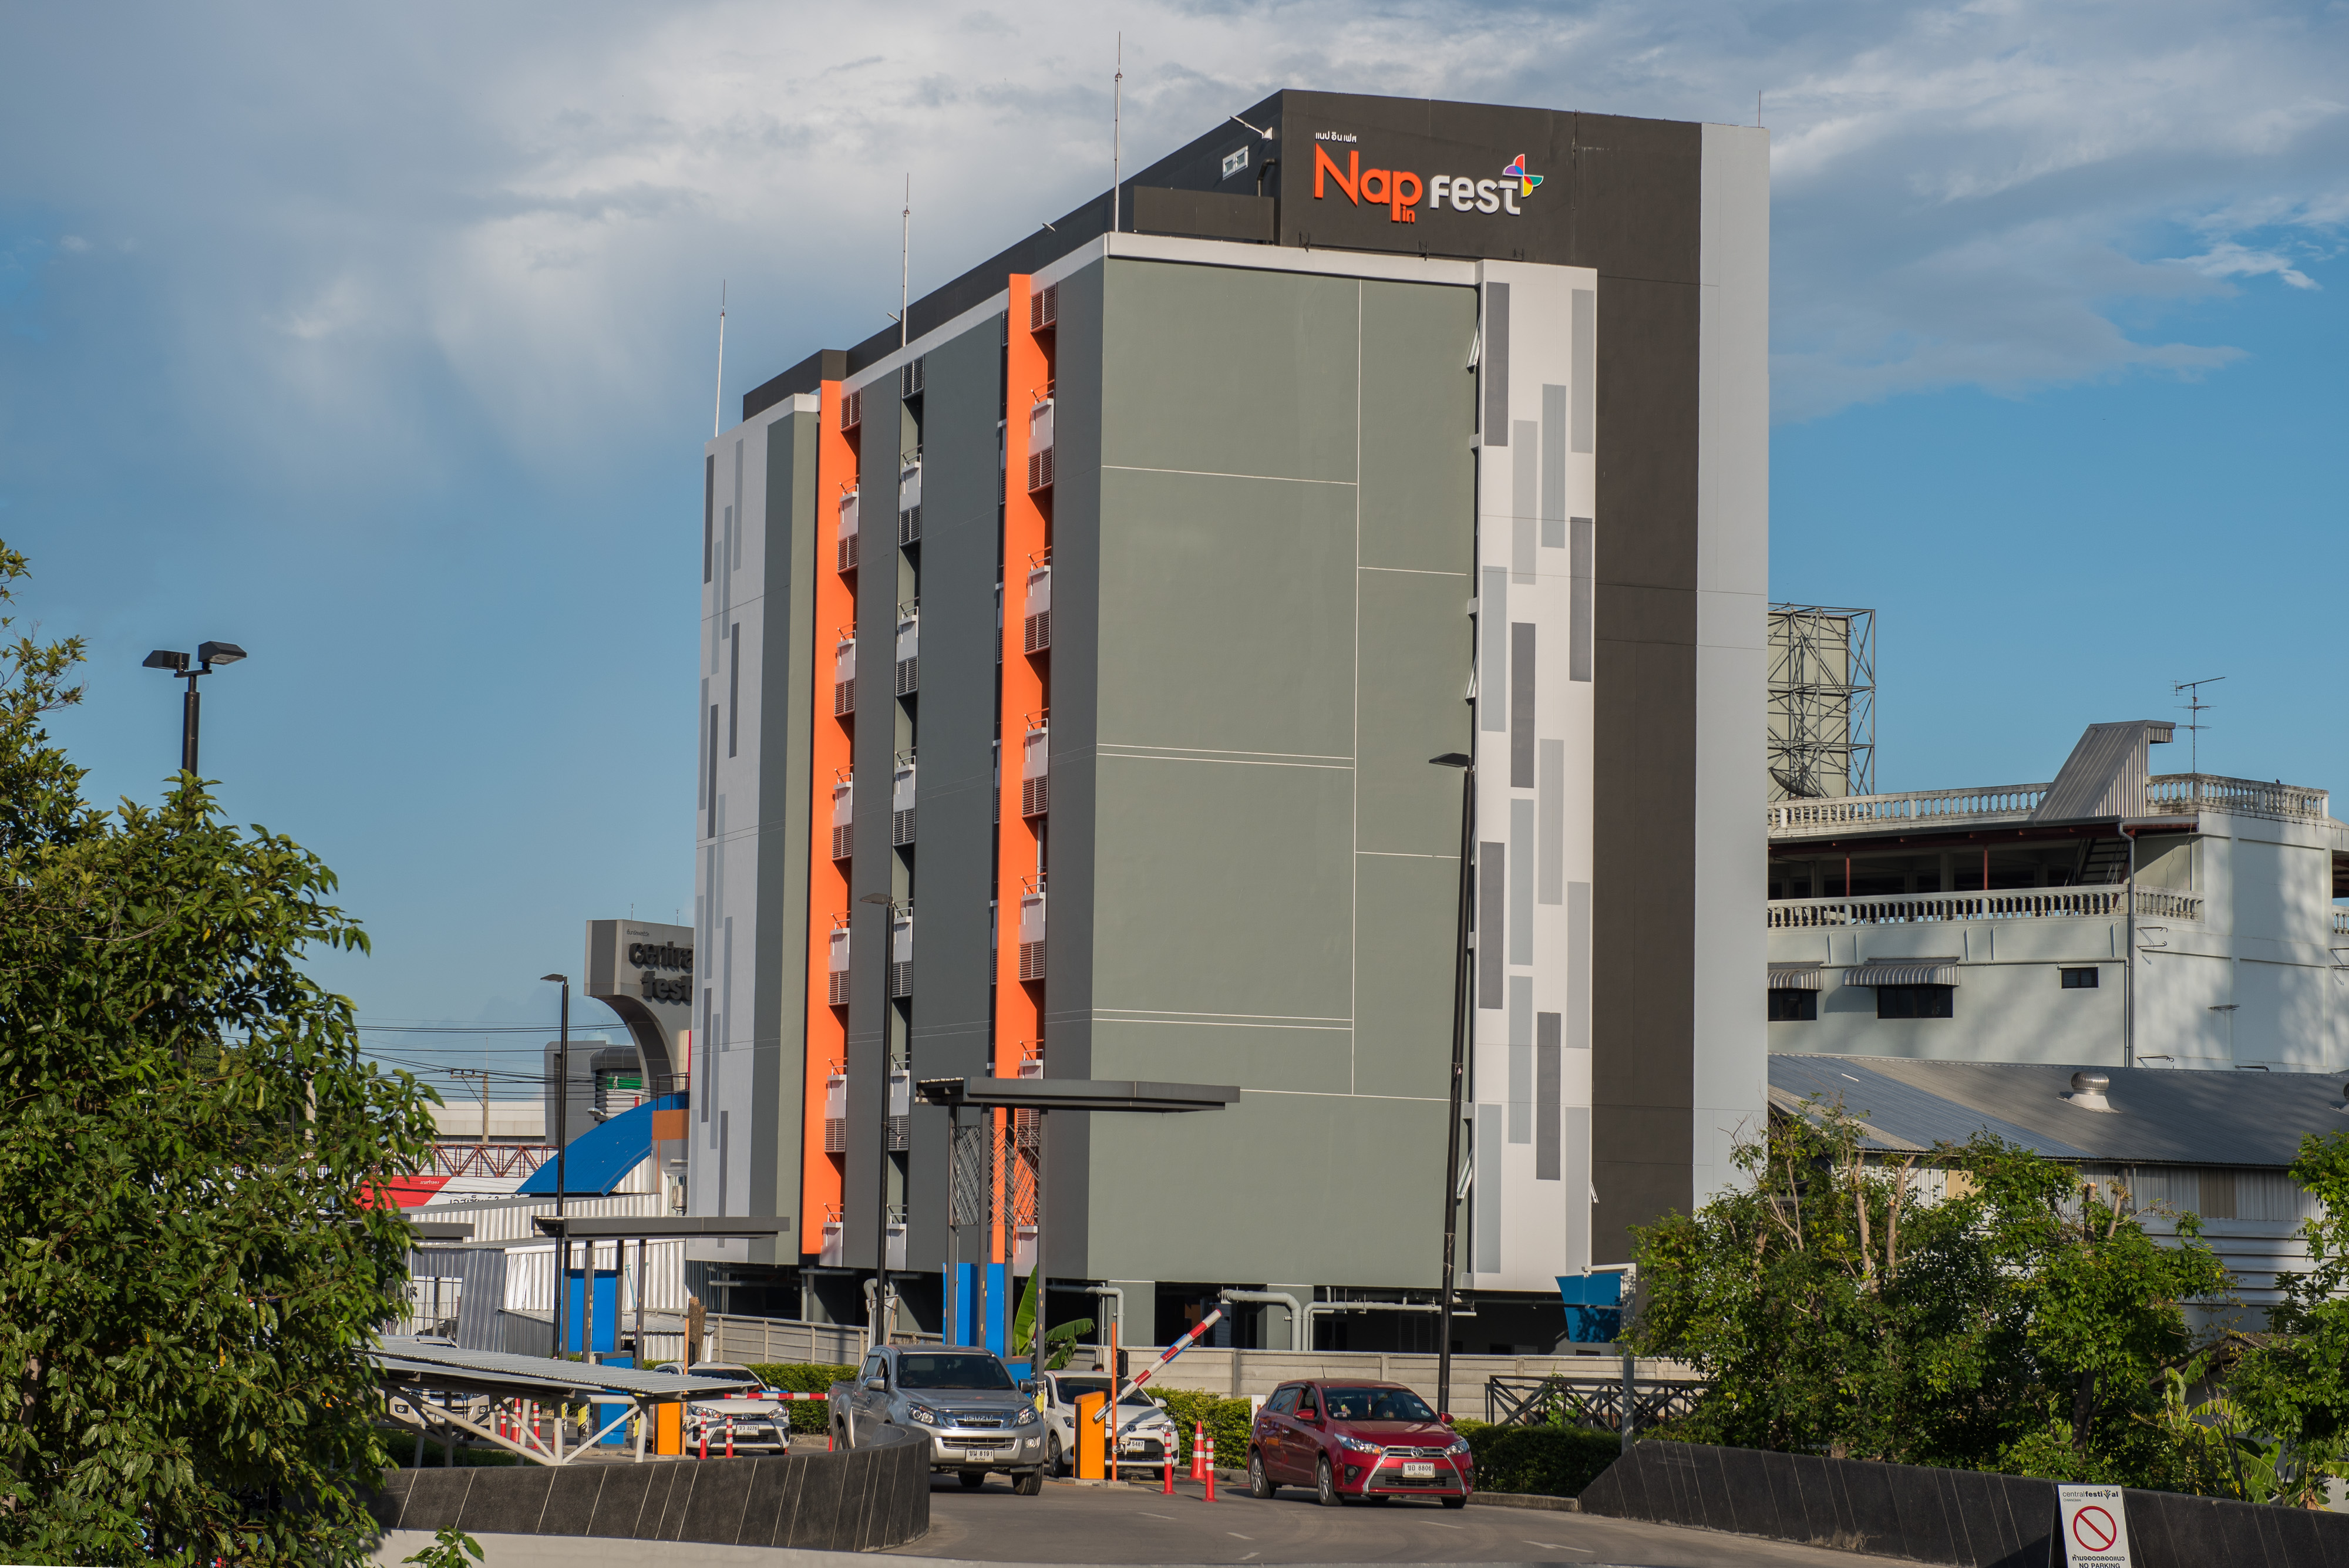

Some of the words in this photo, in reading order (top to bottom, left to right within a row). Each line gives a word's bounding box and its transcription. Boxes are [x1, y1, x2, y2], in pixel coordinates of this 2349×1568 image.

[1315, 130, 1330, 140] แนป
[1343, 133, 1357, 143] เฟส
[1314, 143, 1423, 223] Nap
[1401, 206, 1415, 224] in
[629, 941, 694, 968] centra
